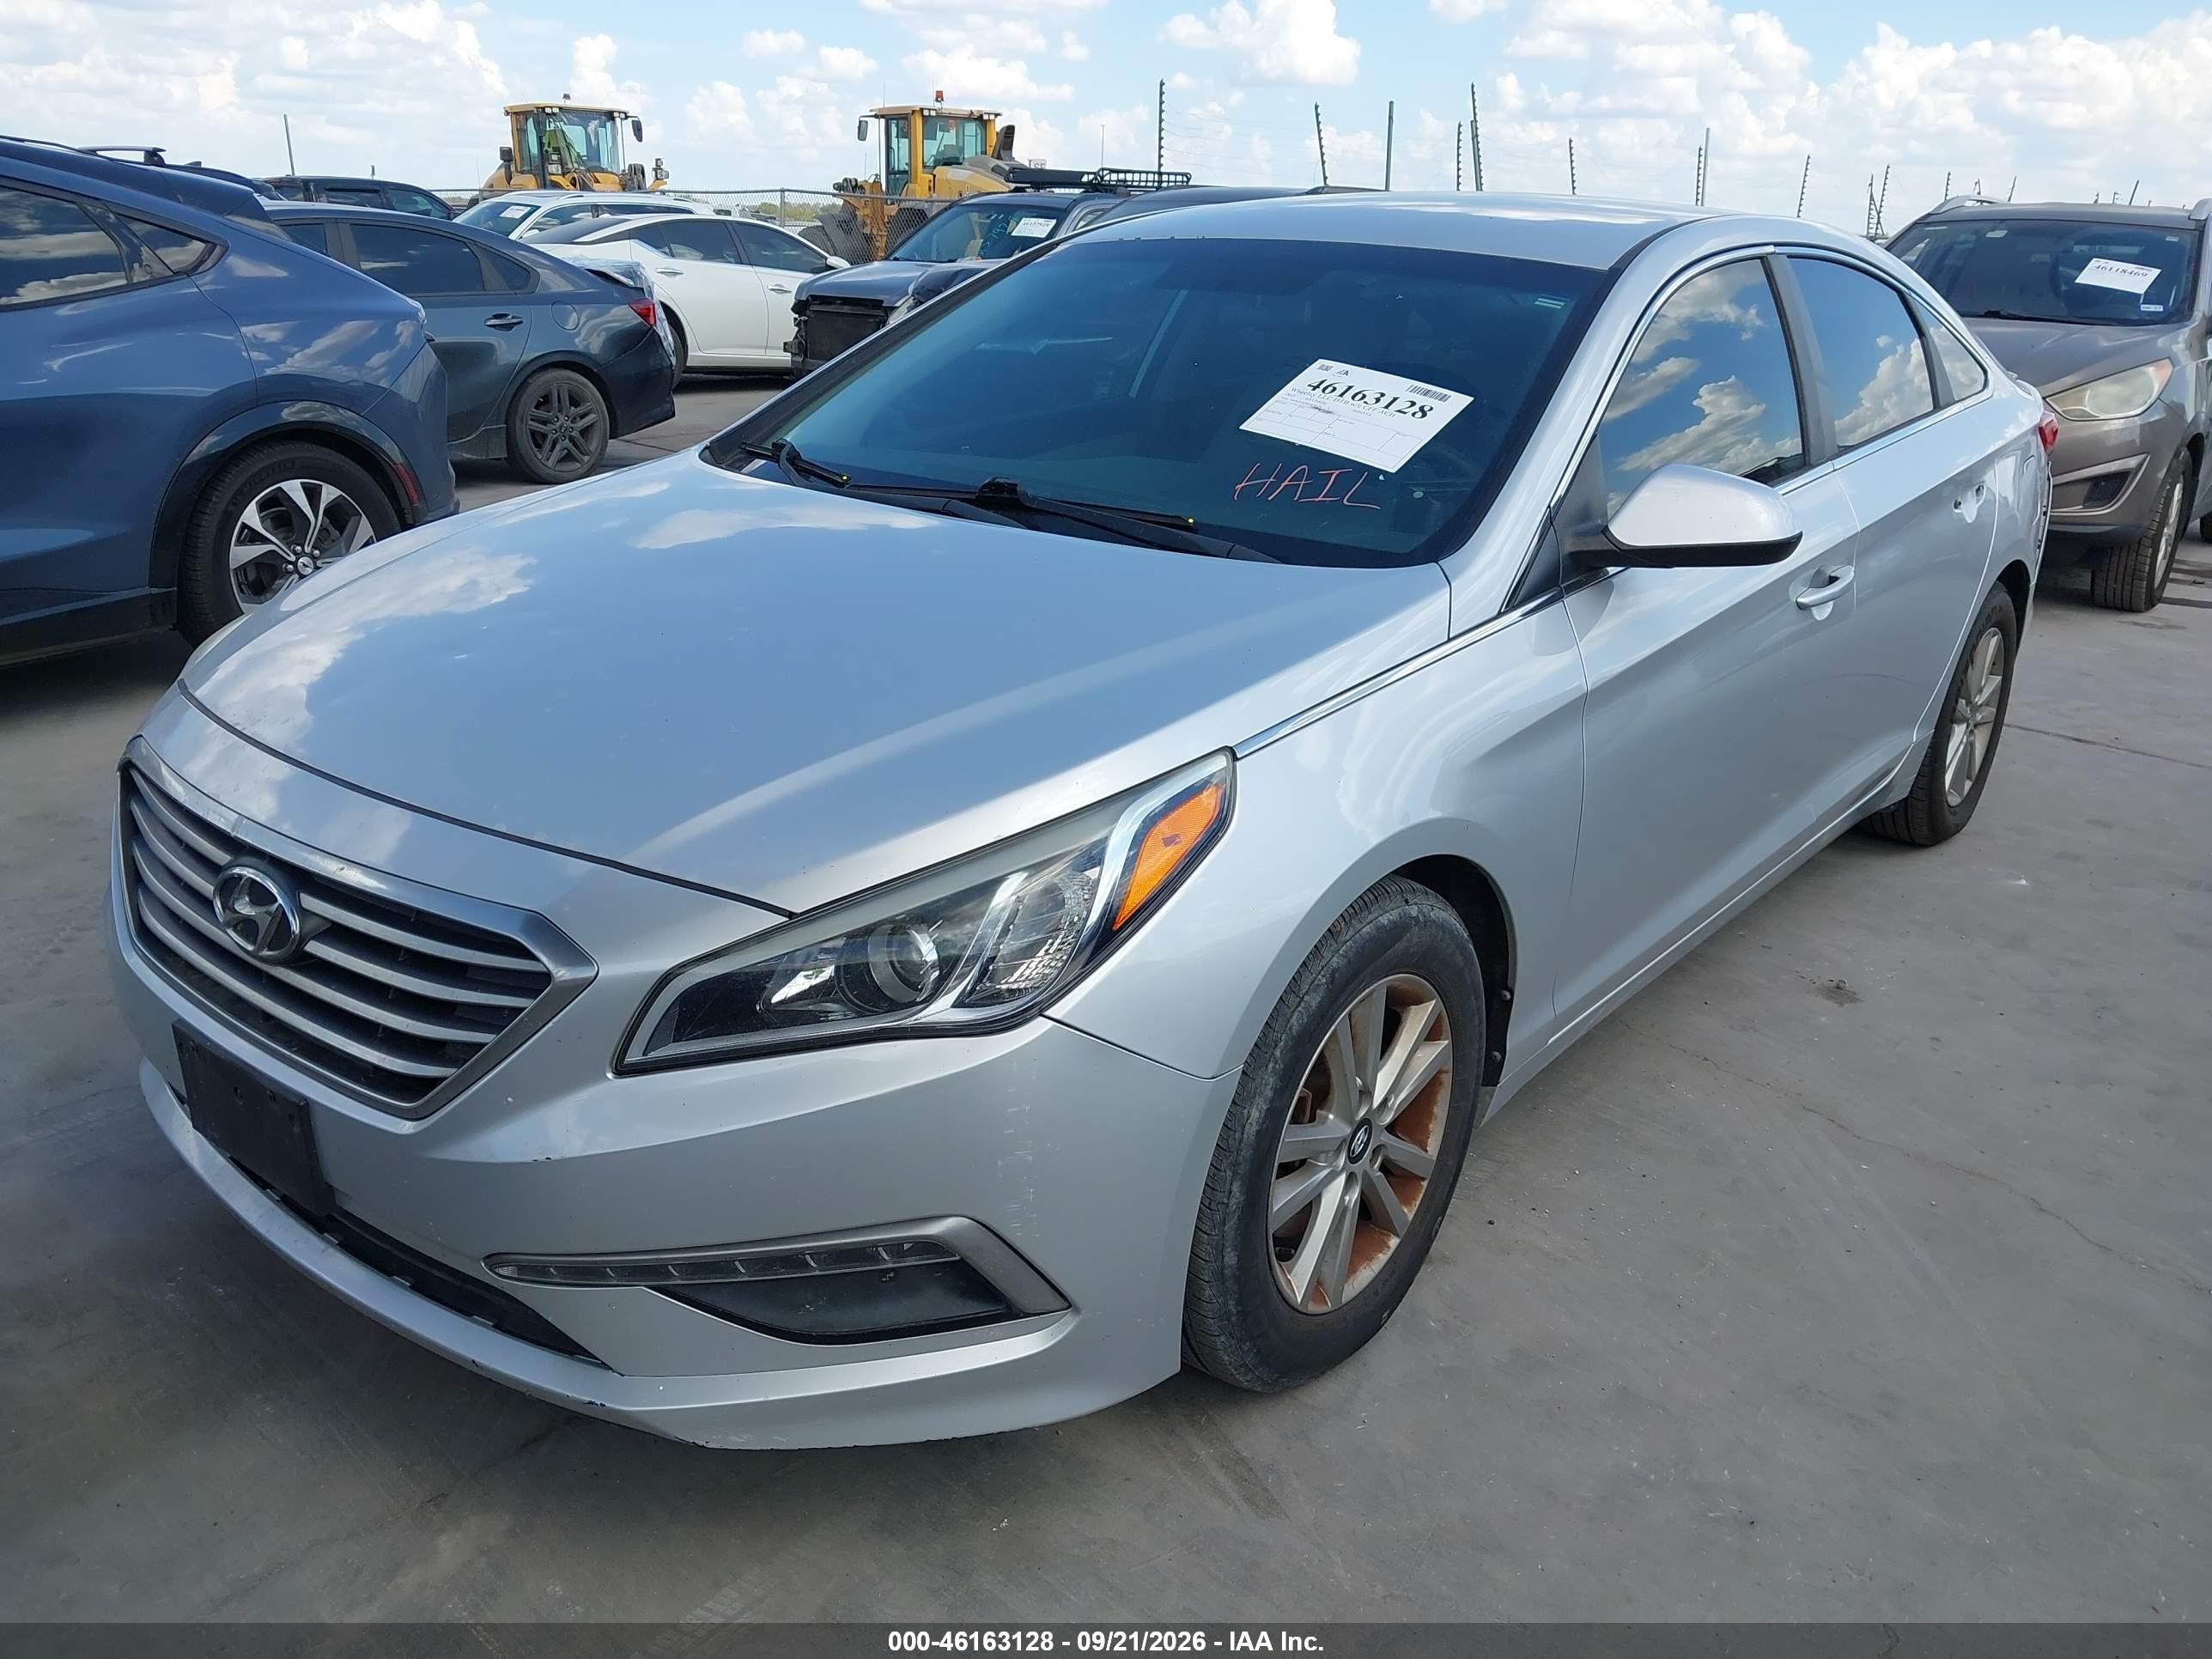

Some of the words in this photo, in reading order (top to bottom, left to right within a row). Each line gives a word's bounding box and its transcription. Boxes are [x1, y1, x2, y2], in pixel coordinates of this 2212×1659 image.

[2094, 264, 2148, 277] 46118469
[1306, 378, 1435, 420] 46163128
[1233, 462, 1382, 509] HAIL
